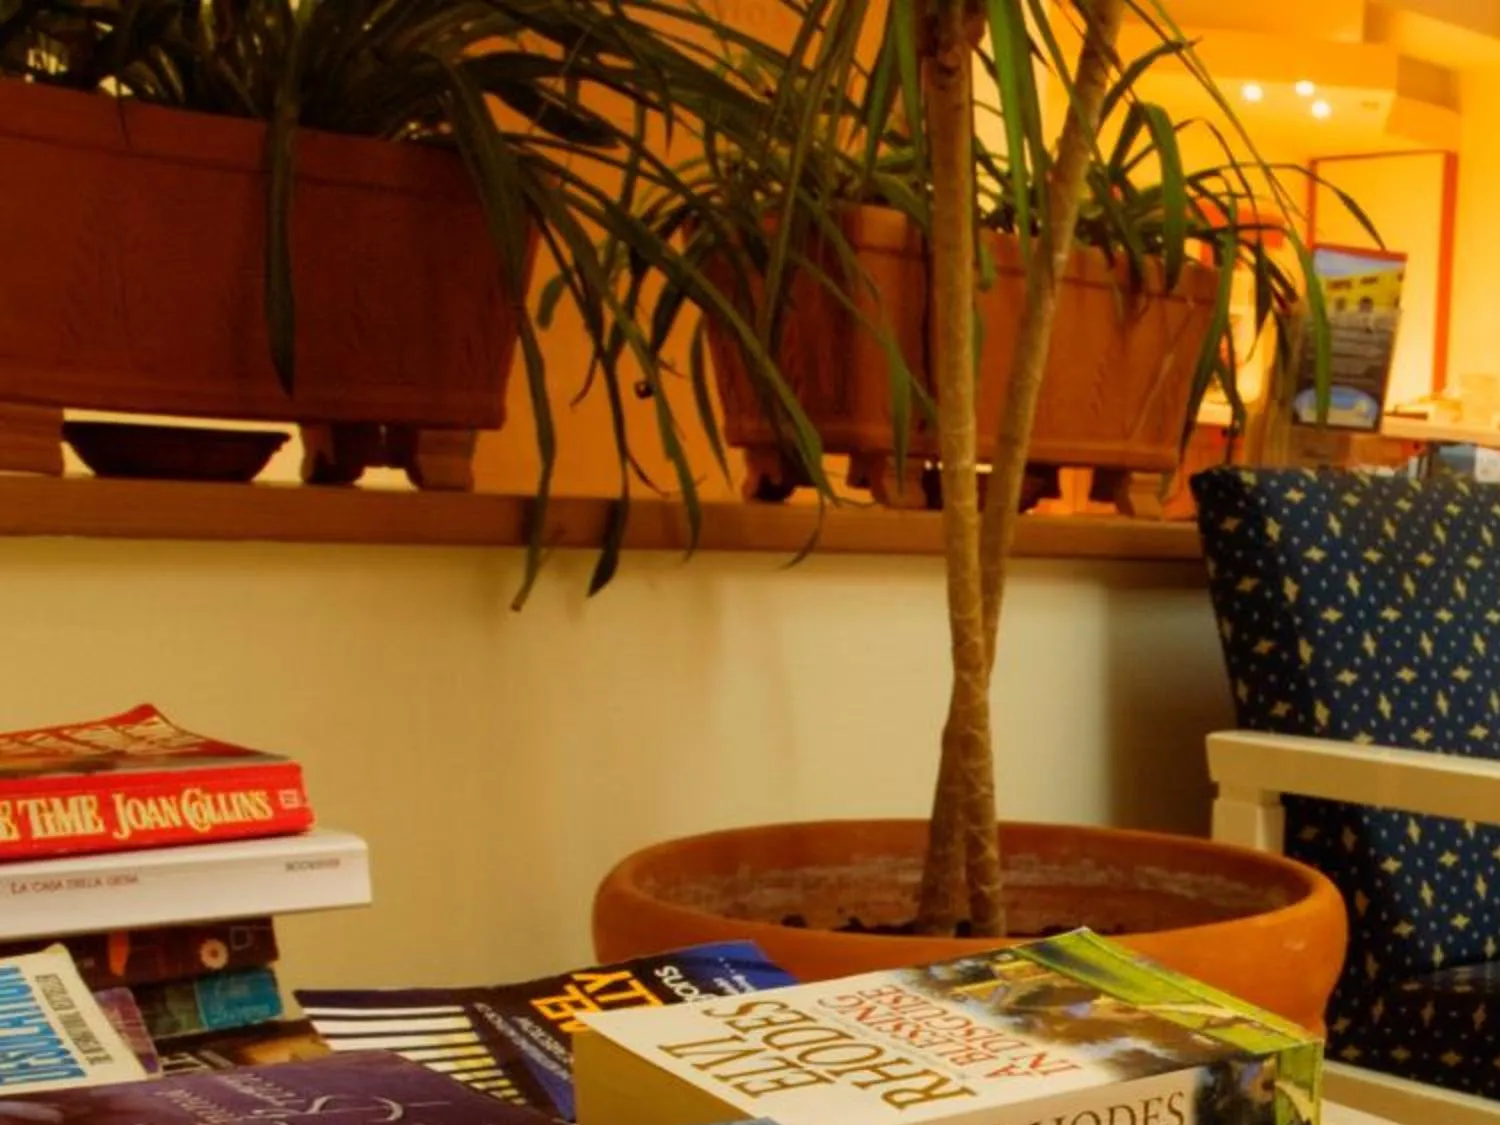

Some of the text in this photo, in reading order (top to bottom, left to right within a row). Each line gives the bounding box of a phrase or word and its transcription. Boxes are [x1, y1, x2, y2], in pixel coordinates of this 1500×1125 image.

[113, 793, 186, 840] JOAN
[182, 787, 274, 833] COLLINS
[703, 999, 981, 1111] RHODES
[857, 982, 1034, 1058] DISGUISE
[657, 1033, 836, 1099] ELVI
